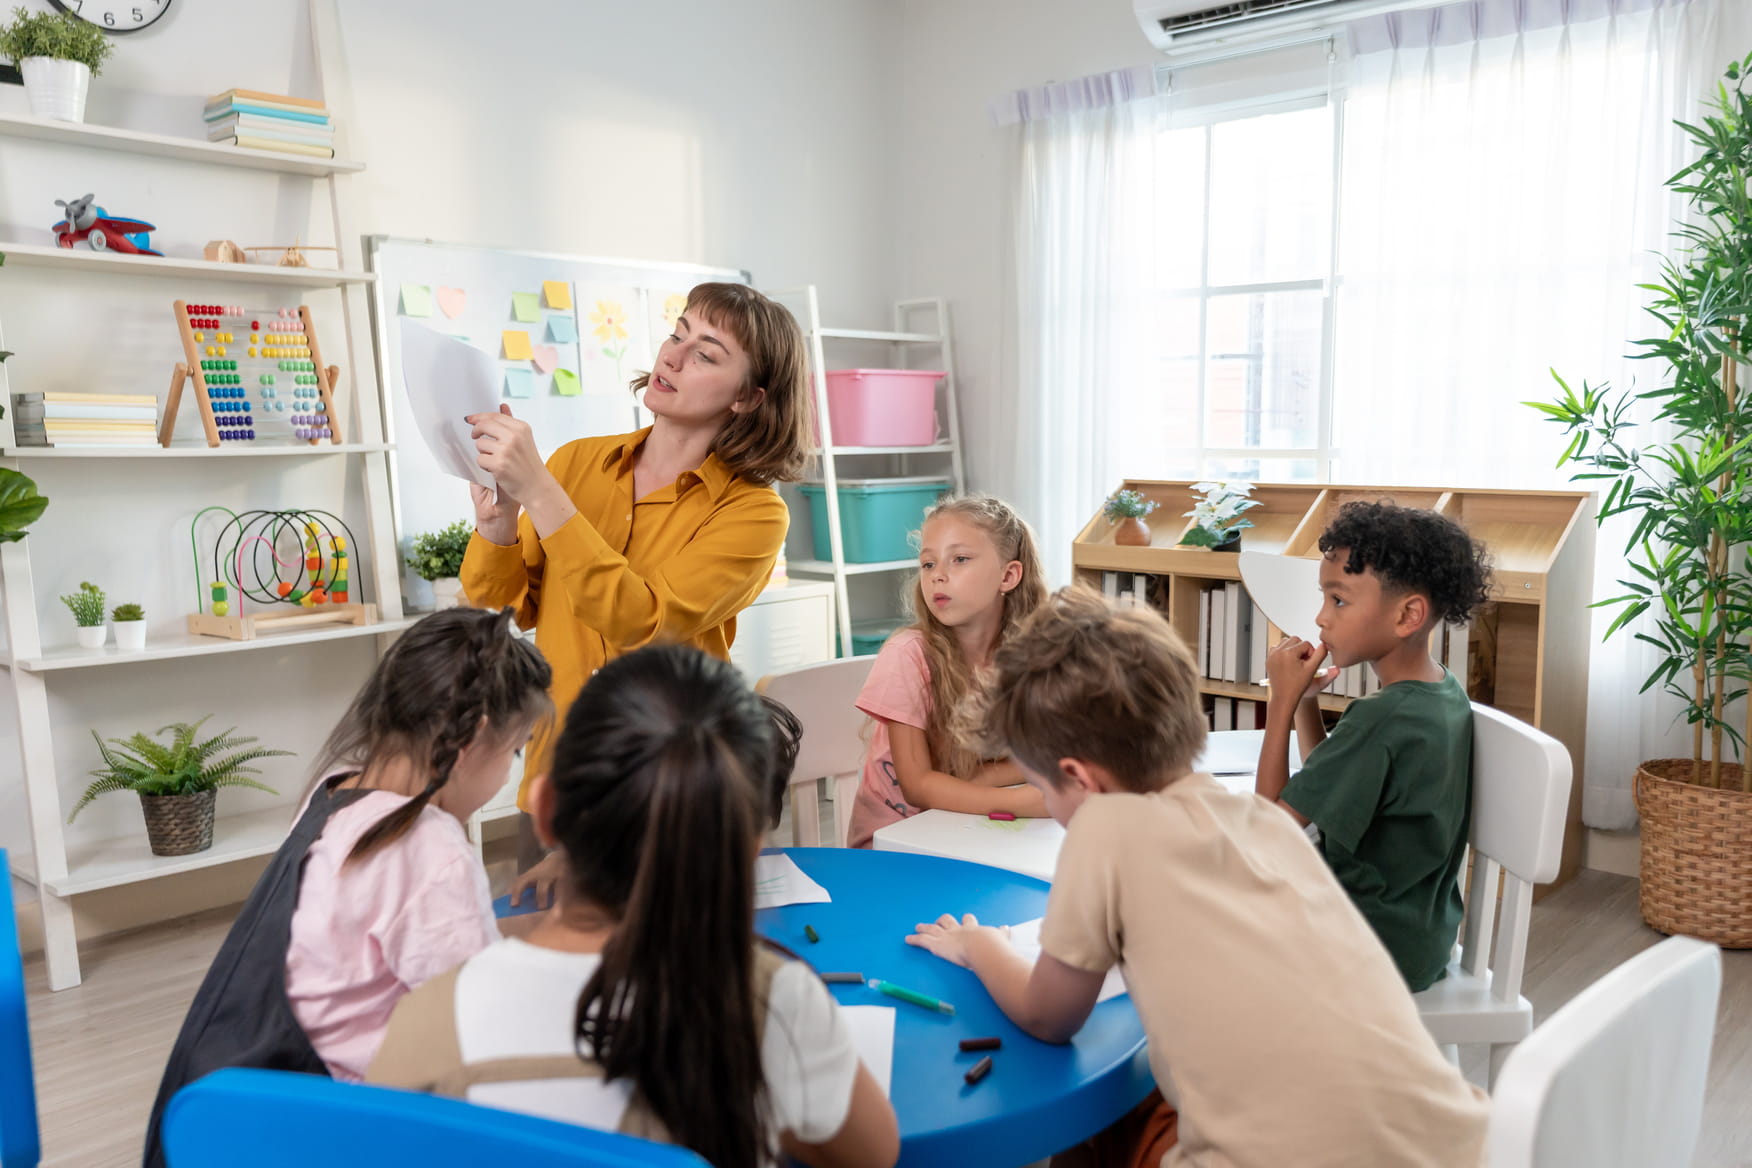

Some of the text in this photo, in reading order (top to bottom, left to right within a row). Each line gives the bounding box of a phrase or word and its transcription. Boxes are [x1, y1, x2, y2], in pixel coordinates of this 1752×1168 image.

[72, 0, 83, 14] 7
[103, 12, 115, 26] 6
[132, 8, 144, 22] 5
